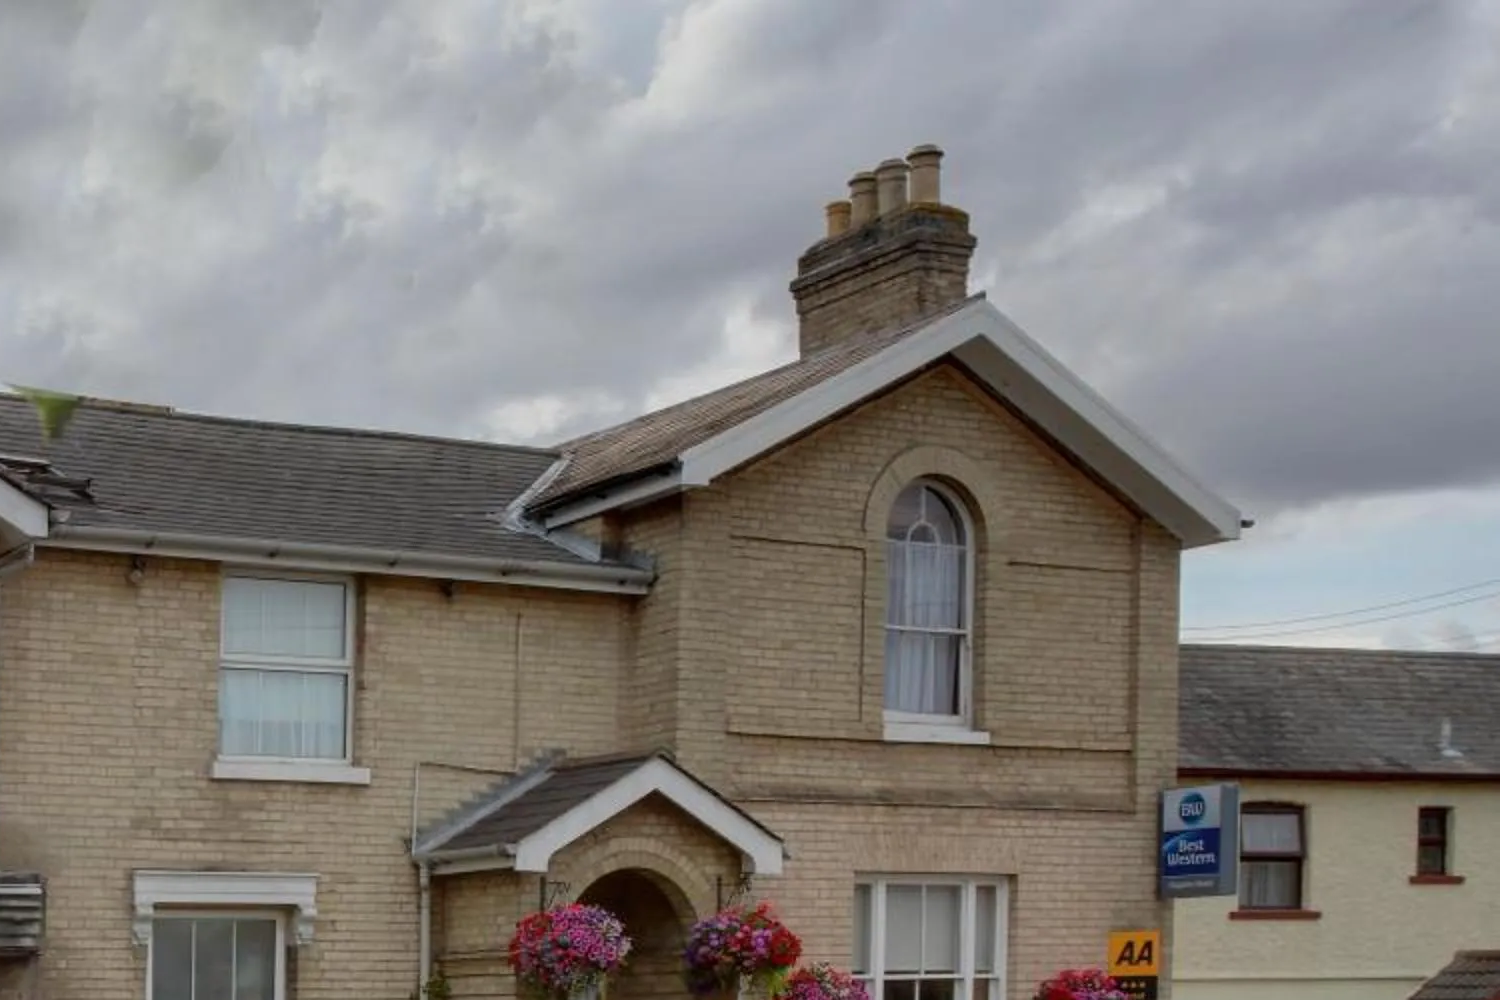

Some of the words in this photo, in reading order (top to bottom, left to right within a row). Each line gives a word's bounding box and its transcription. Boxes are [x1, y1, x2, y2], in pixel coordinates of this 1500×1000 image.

[1179, 839, 1204, 853] Best
[1167, 852, 1216, 867] Western
[1116, 940, 1153, 966] AA
